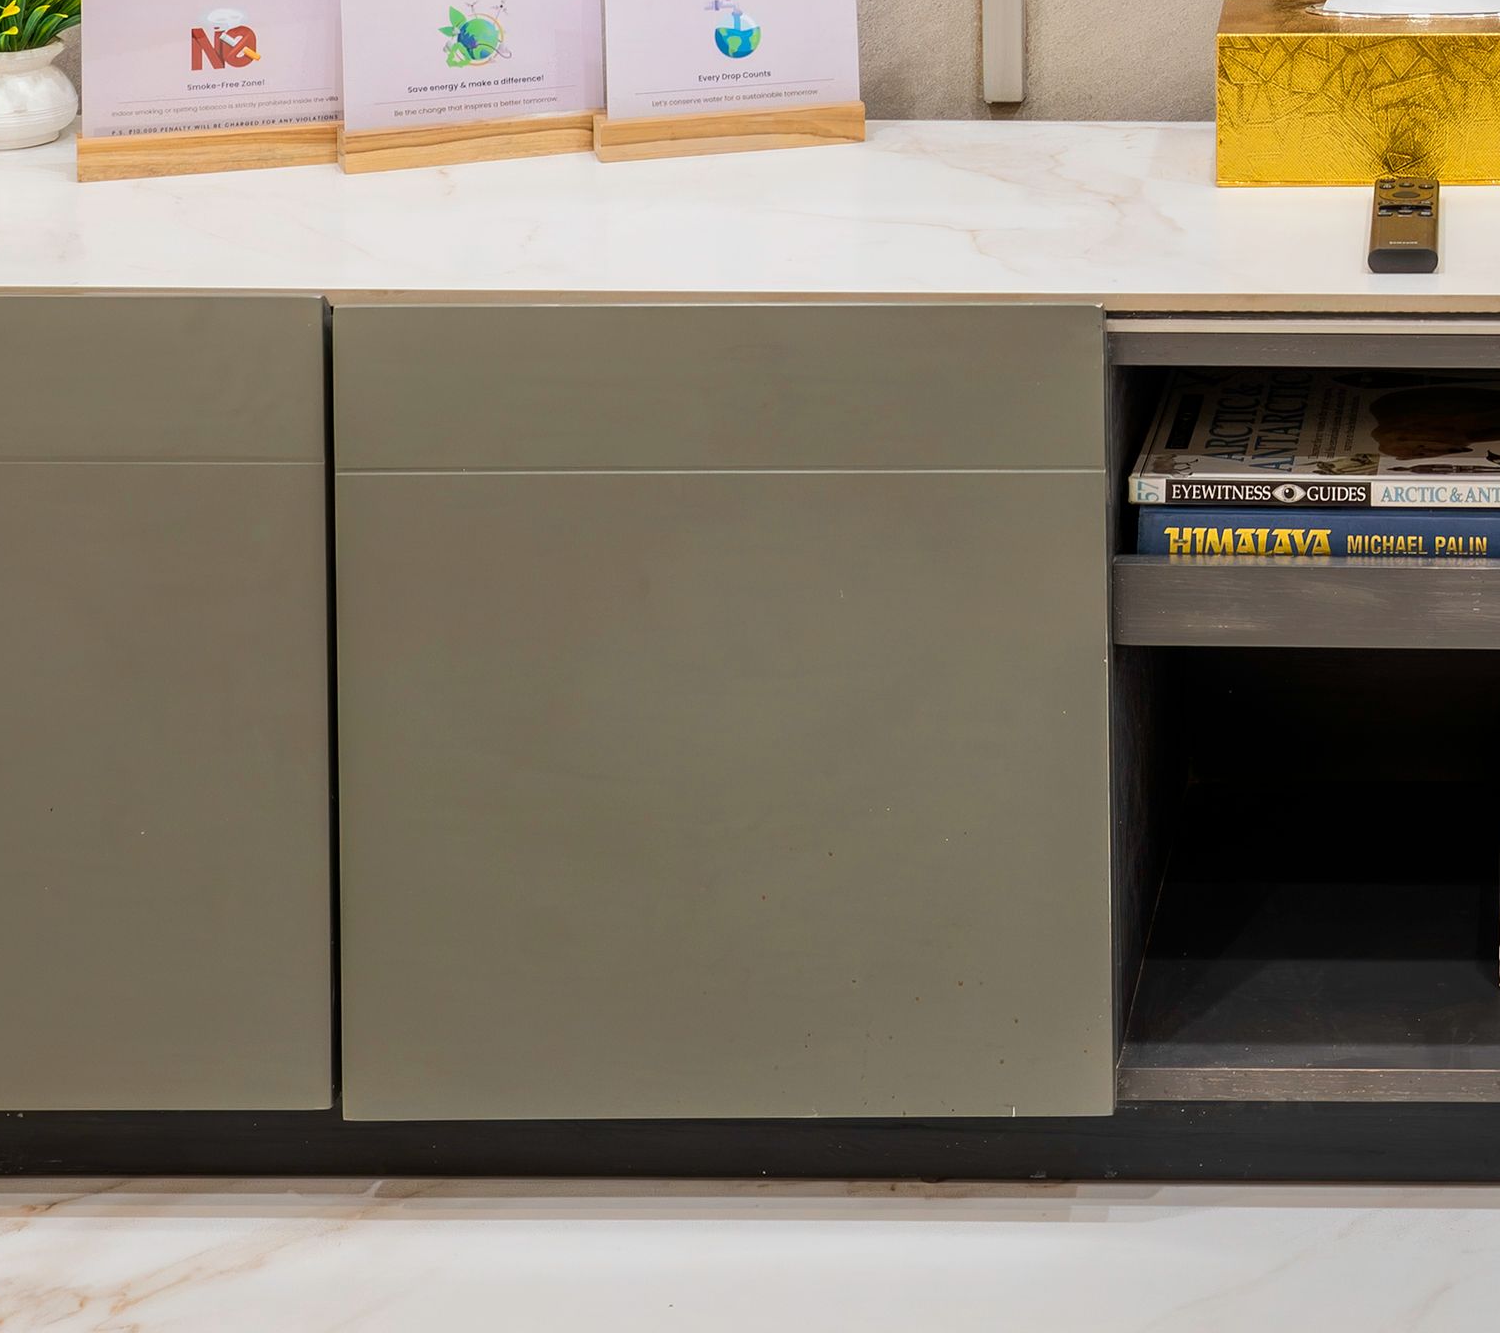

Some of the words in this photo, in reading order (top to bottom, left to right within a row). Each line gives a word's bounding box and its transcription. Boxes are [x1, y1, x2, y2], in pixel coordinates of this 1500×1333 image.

[187, 81, 239, 92] Smoke-Free
[241, 78, 266, 88] Zone!
[407, 85, 428, 94] Save
[429, 83, 459, 93] energy
[459, 81, 467, 89] &
[468, 78, 492, 88] make
[500, 74, 544, 85] difference!
[698, 74, 720, 83] Every
[721, 72, 742, 82] Drop
[743, 69, 771, 79] Counts
[394, 109, 404, 117] Be
[404, 108, 416, 116] the
[417, 106, 446, 116] change
[447, 104, 463, 112] that
[464, 101, 491, 112] inspires
[500, 98, 521, 107] better
[651, 99, 668, 108] Let's
[669, 98, 702, 107] conserve
[703, 95, 723, 104] water
[724, 94, 734, 102] for
[742, 90, 782, 101] sustainable
[160, 125, 191, 133] PENALTY
[224, 120, 259, 129] CHARGED
[296, 114, 339, 123] VIOLATIONS
[1138, 481, 1160, 502] 57
[1171, 484, 1271, 501] EYEWITNESS
[1306, 486, 1366, 502] GUIDES
[1380, 486, 1447, 503] ARCTIC
[1449, 486, 1464, 503] &
[1164, 527, 1332, 556] HIMALAYA
[1347, 535, 1428, 554] MICHAEL
[1434, 536, 1487, 555] PALIN
